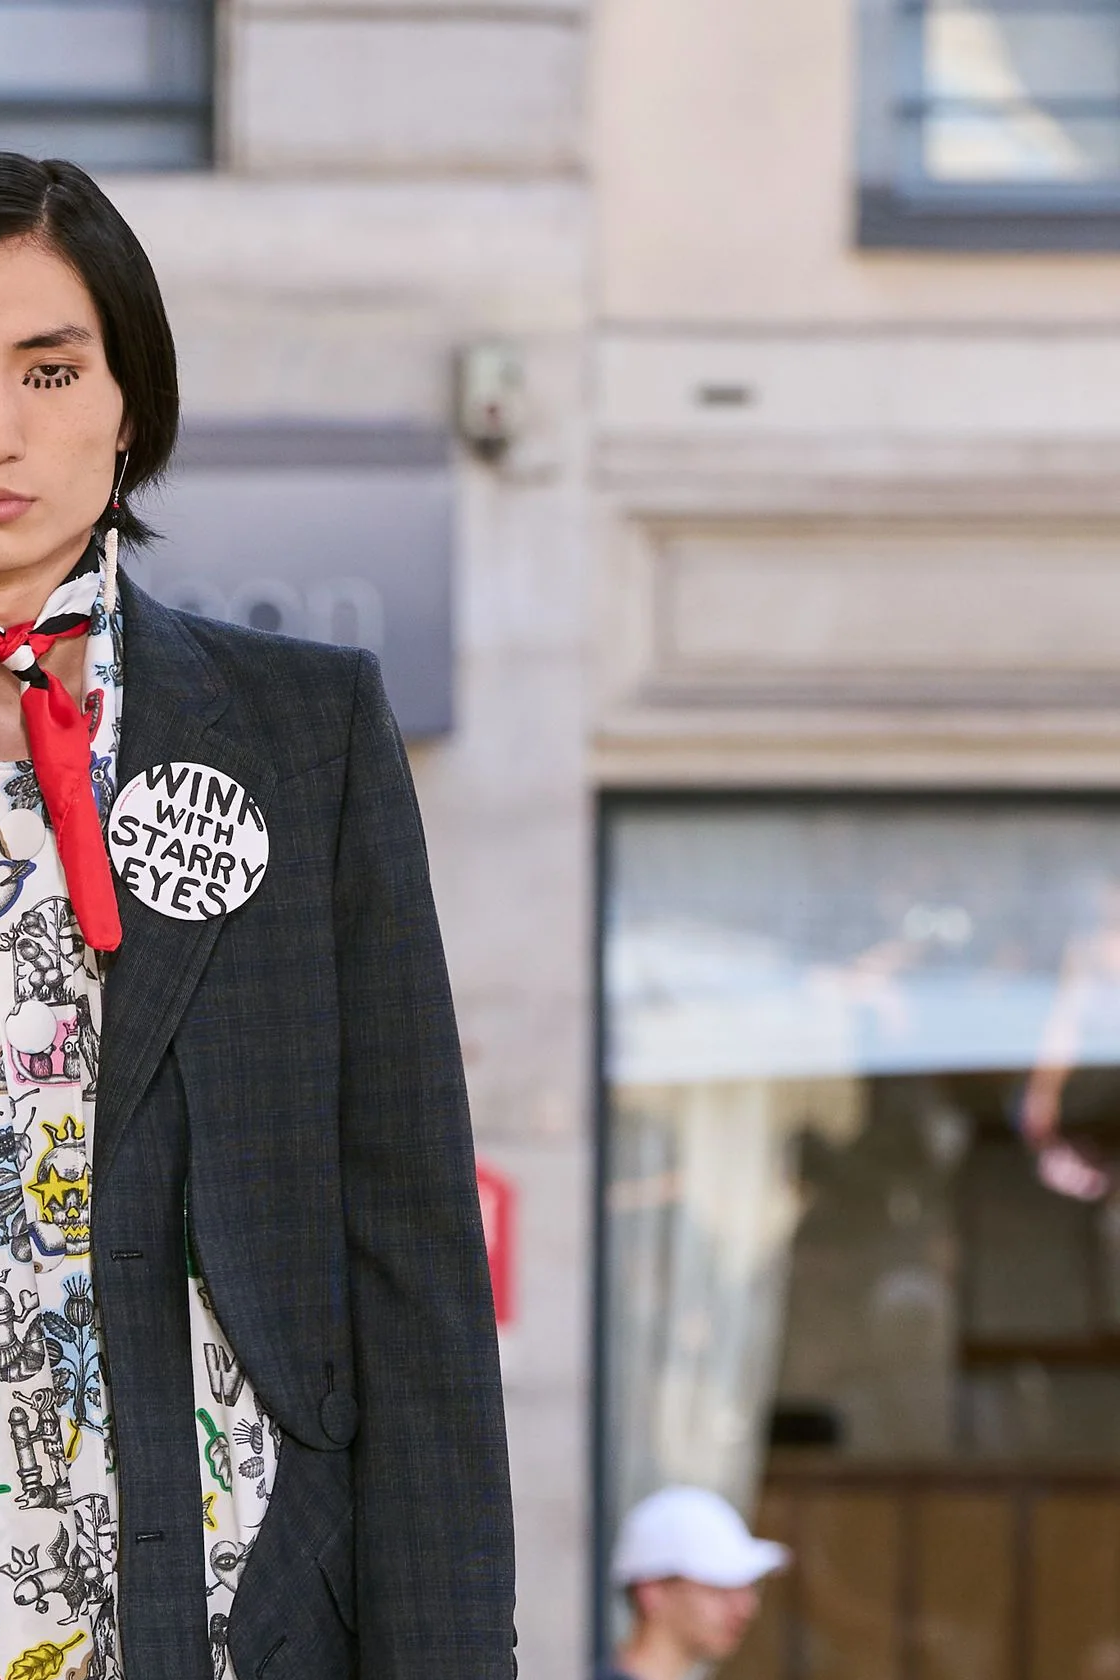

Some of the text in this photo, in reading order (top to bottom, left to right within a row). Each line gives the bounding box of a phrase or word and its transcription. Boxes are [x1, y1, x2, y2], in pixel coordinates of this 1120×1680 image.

[145, 763, 264, 832] WINK
[156, 799, 234, 846] WITH
[111, 815, 265, 893] STARRY
[120, 857, 227, 919] EYES
